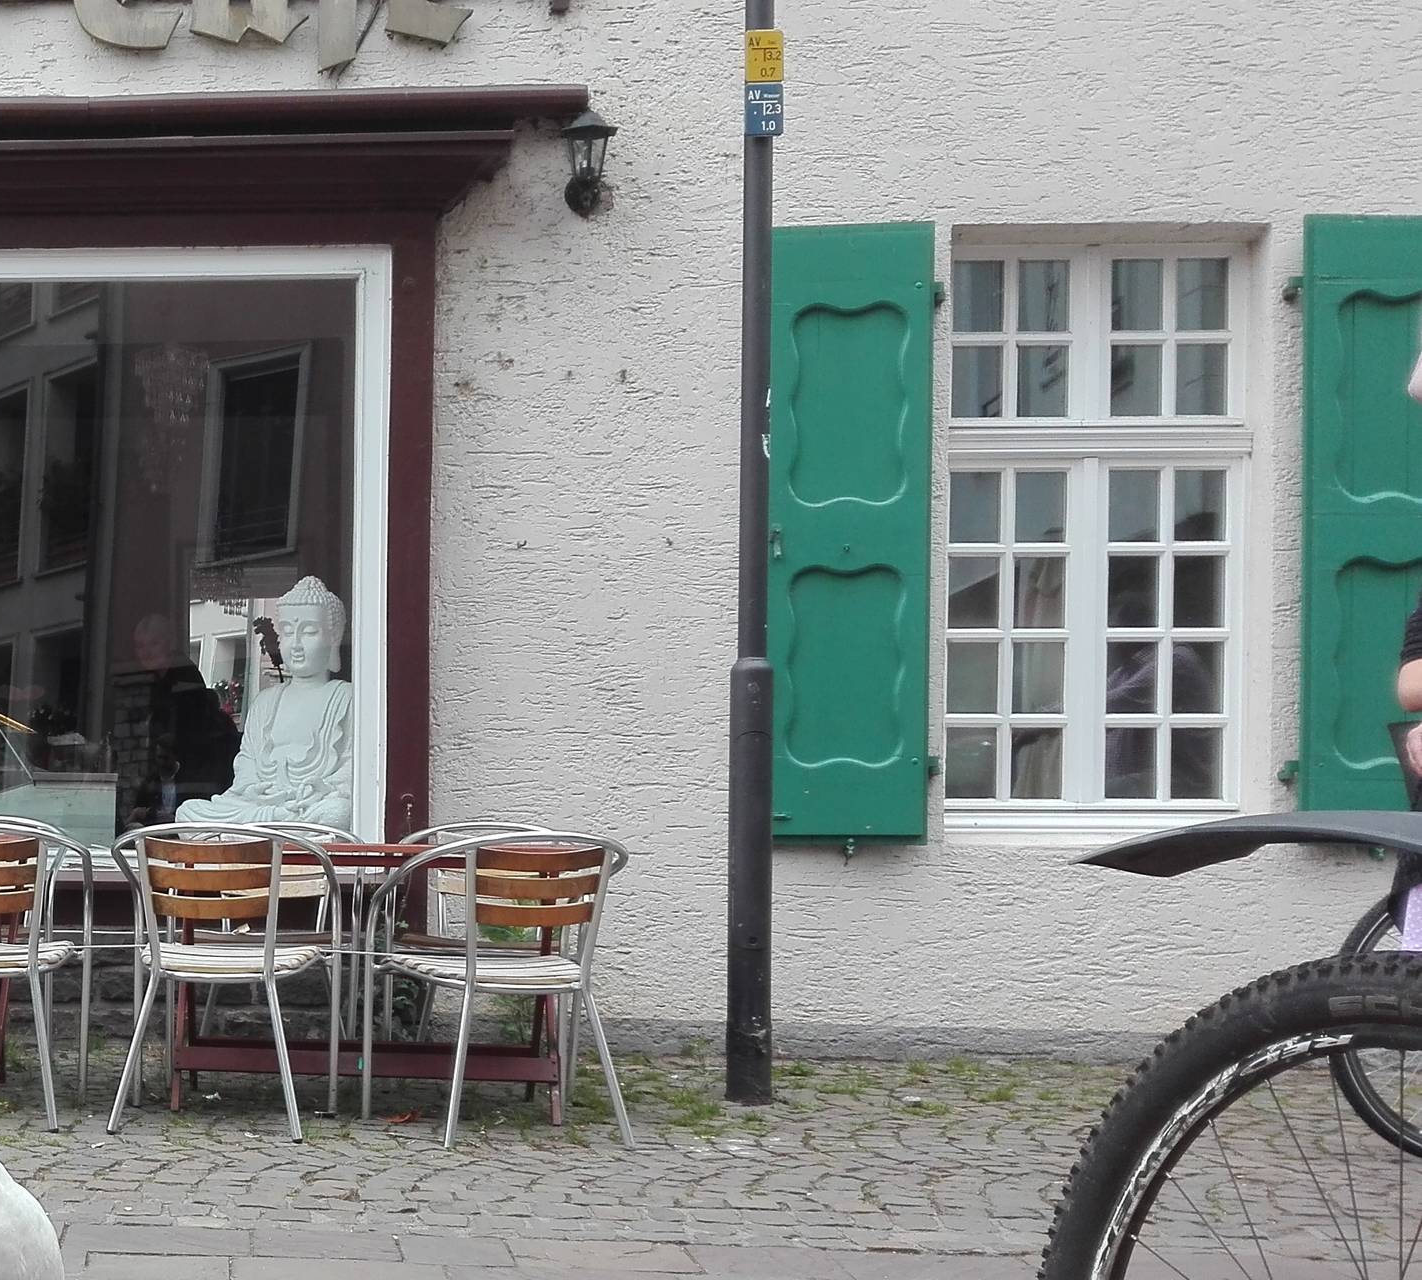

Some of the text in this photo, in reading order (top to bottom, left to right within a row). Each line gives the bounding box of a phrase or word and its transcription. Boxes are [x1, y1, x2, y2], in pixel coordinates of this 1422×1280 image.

[748, 36, 761, 47] AV
[765, 50, 782, 61] 3.2
[760, 67, 776, 78] 0.7
[748, 90, 761, 101] AV
[765, 104, 782, 115] 2.3
[761, 120, 776, 131] 1.0
